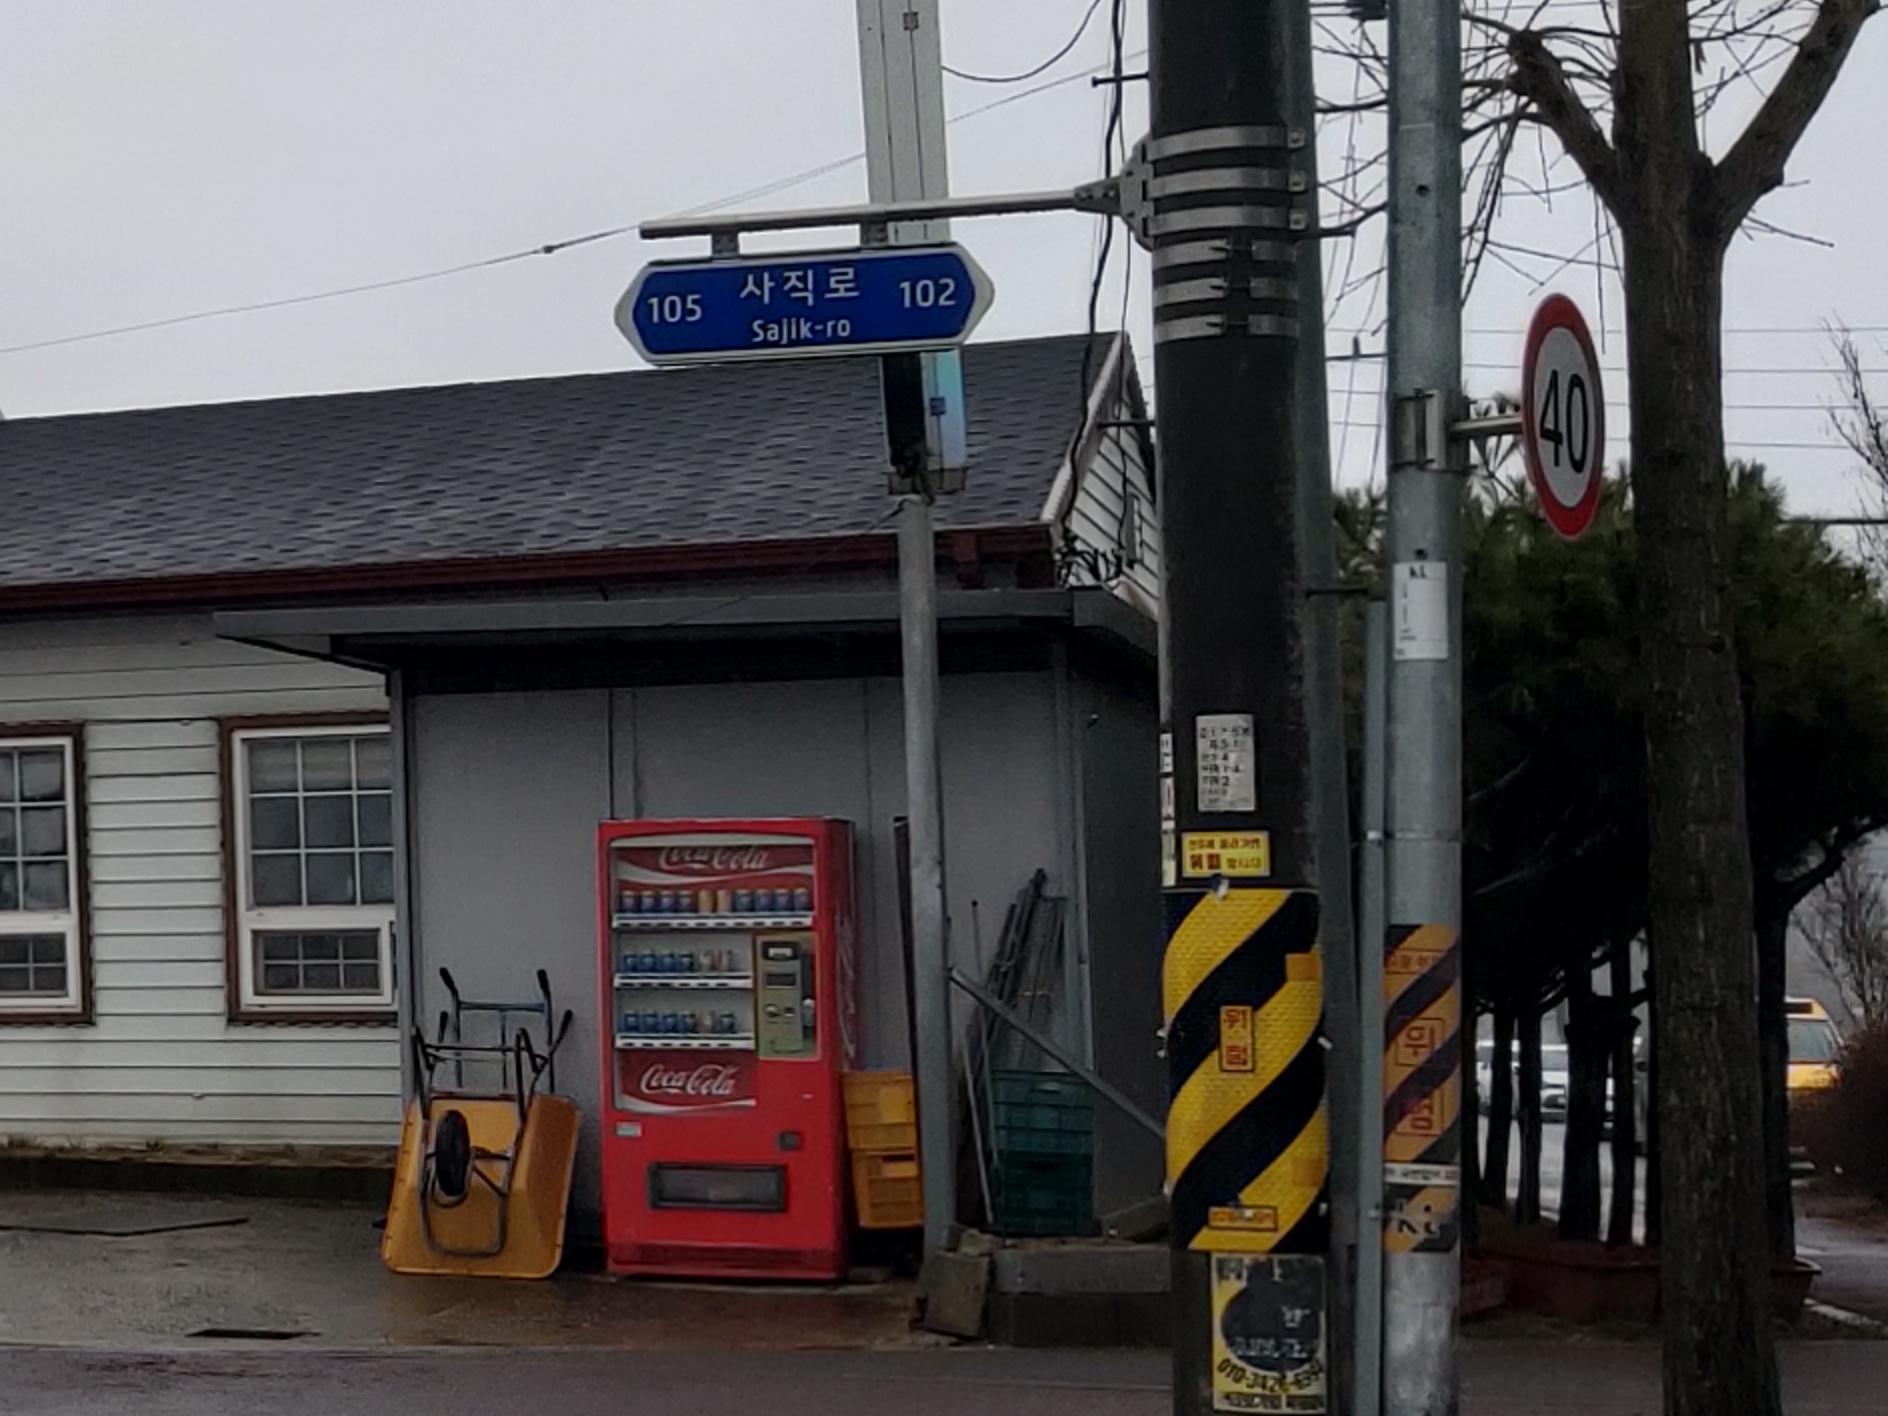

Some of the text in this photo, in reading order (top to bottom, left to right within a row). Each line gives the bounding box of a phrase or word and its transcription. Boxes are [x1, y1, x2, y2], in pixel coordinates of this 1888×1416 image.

[647, 267, 957, 324] 105 사직로 102
[751, 317, 851, 346] Sajik-ro
[1539, 368, 1589, 474] 40
